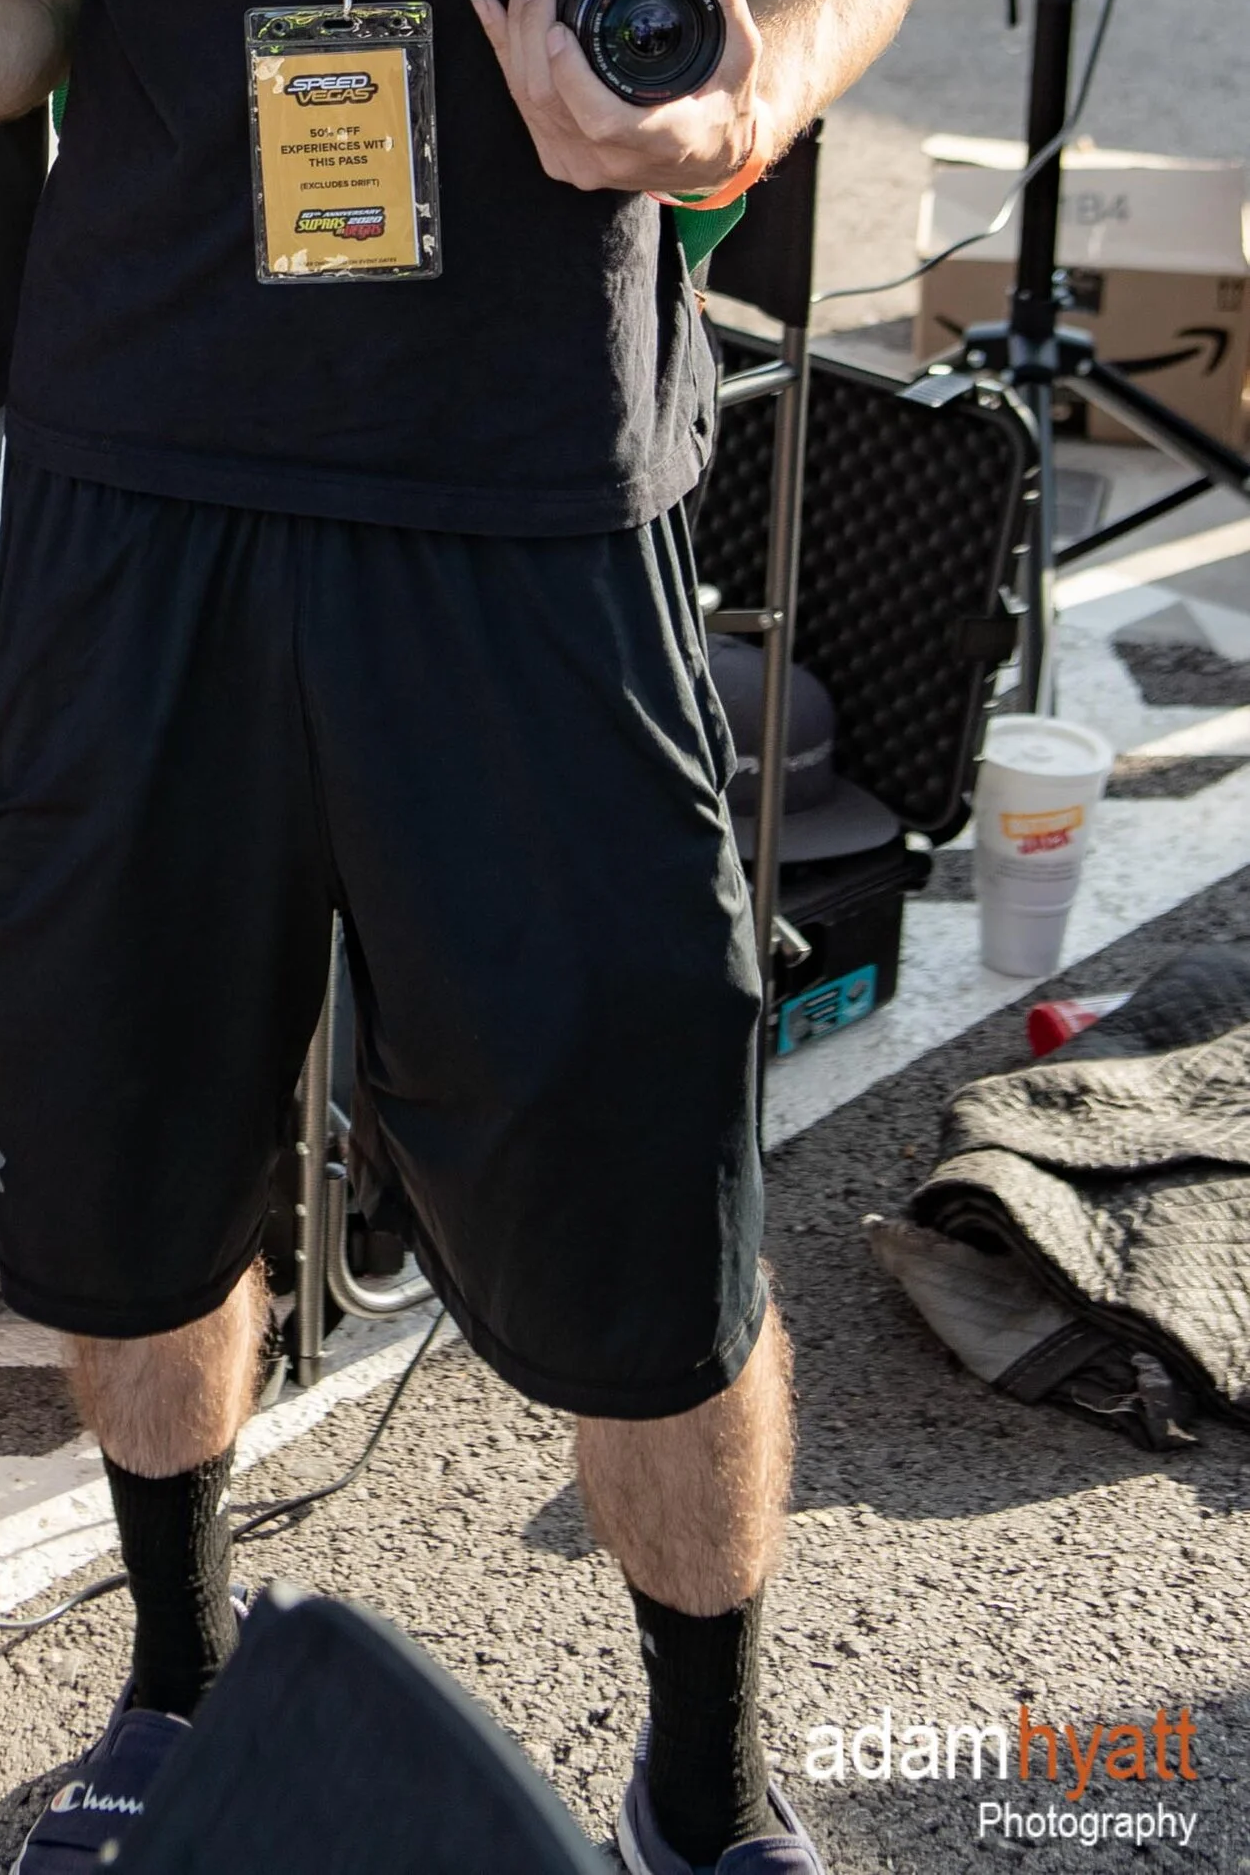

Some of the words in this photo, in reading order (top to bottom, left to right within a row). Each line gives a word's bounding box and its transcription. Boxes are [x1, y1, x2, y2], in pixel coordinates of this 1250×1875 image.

[288, 75, 368, 92] SPEED
[297, 87, 375, 103] VEGAS
[281, 141, 361, 155] EXPERIENCES
[309, 158, 335, 168] THIS
[339, 156, 368, 166] PASS
[300, 180, 349, 192] (EXCLUDES
[351, 178, 380, 188] DRIFT)
[298, 217, 347, 231] SUPRAS
